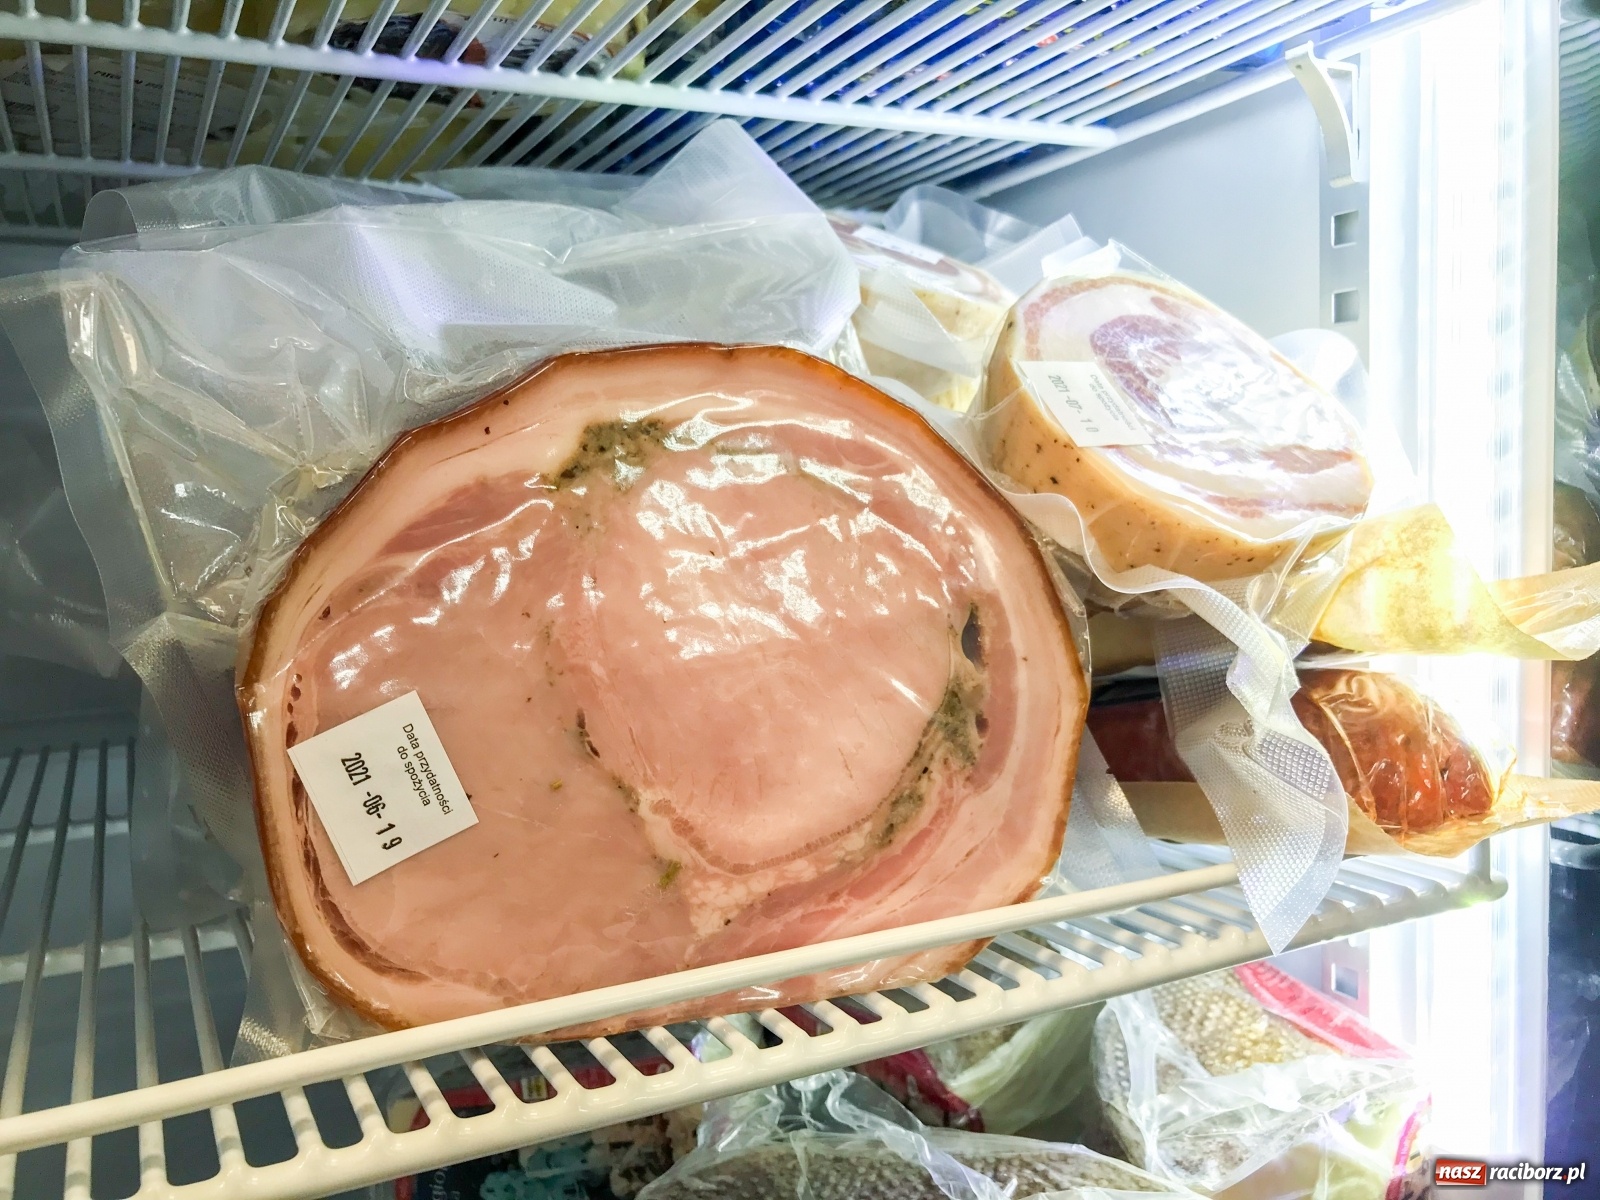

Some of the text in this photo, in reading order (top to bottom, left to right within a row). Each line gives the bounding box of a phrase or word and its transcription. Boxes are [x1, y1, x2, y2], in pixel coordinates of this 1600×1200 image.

[1047, 374, 1070, 393] 2021
[340, 752, 372, 786] 2021
[396, 745, 431, 807] do spożycia
[402, 722, 454, 816] Data przydatności
